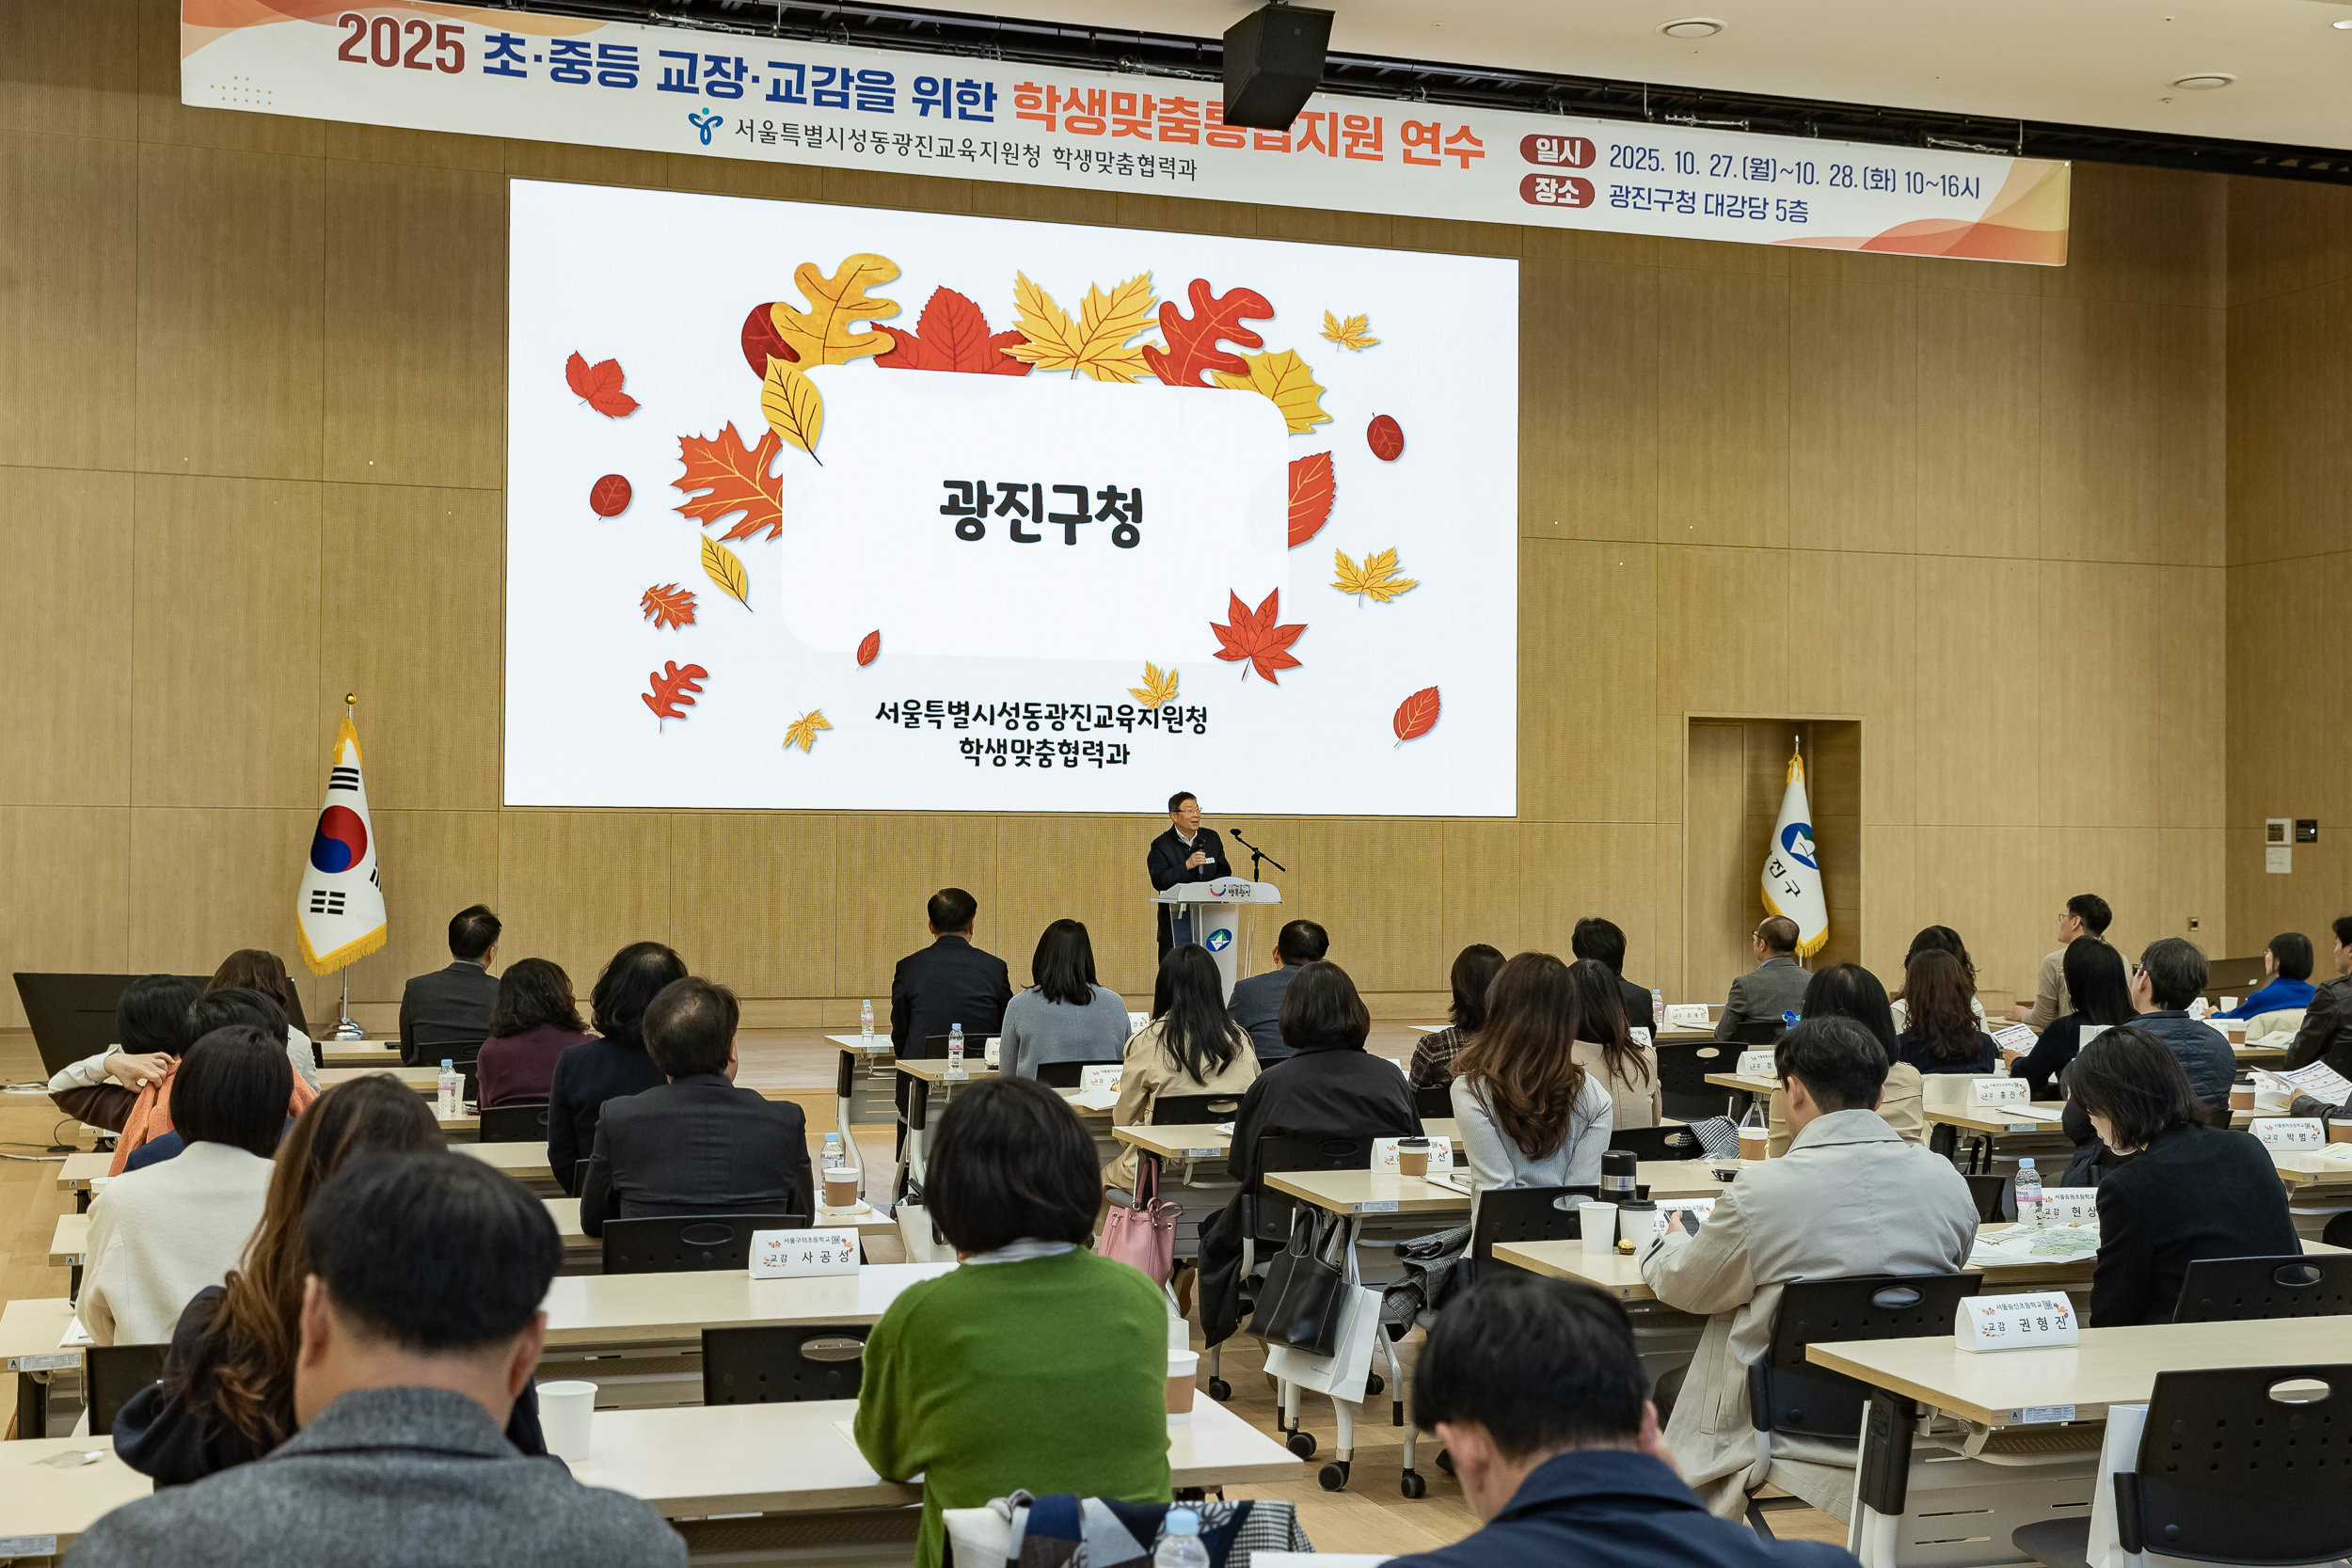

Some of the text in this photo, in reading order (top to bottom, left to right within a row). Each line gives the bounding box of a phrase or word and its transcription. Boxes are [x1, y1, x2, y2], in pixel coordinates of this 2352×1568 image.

[338, 13, 465, 74] 2025
[657, 49, 897, 114] 교장·교감을
[912, 75, 998, 123] 위한
[1400, 119, 1486, 170] 연수
[735, 119, 1198, 182] 서울특별시성동광진교육지원청 학생맞춤협력과
[1535, 137, 1581, 166] 일시
[1610, 144, 1665, 172] 2025.
[1675, 150, 1700, 175] 10.
[1905, 171, 1980, 199] 10~16시
[1534, 177, 1581, 205] 장소
[1609, 184, 1809, 224] 광진구청 대강당 5층
[940, 480, 1143, 548] 광진구청
[875, 699, 1208, 734] 서울특별시성동광진교육지원청
[960, 736, 1130, 768] 학생맞춤협력과
[2044, 1208, 2060, 1216] 교감
[771, 1254, 787, 1262] 교감
[1988, 1322, 2006, 1332] 교감
